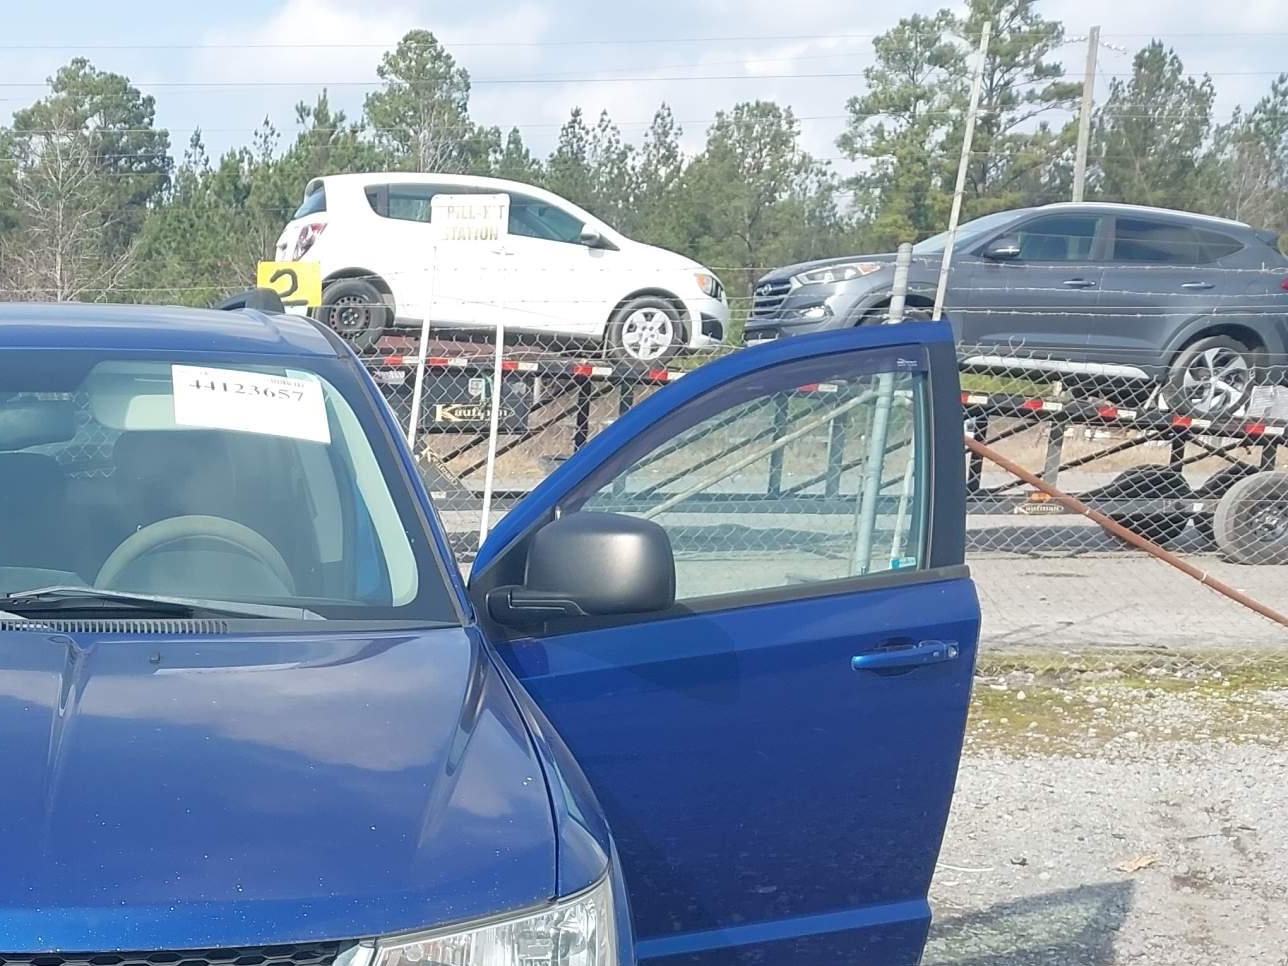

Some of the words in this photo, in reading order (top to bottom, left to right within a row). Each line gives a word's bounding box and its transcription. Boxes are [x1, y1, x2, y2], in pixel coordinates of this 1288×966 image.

[270, 267, 309, 307] 2
[189, 379, 304, 402] 44123657
[435, 403, 508, 422] Kaufn
